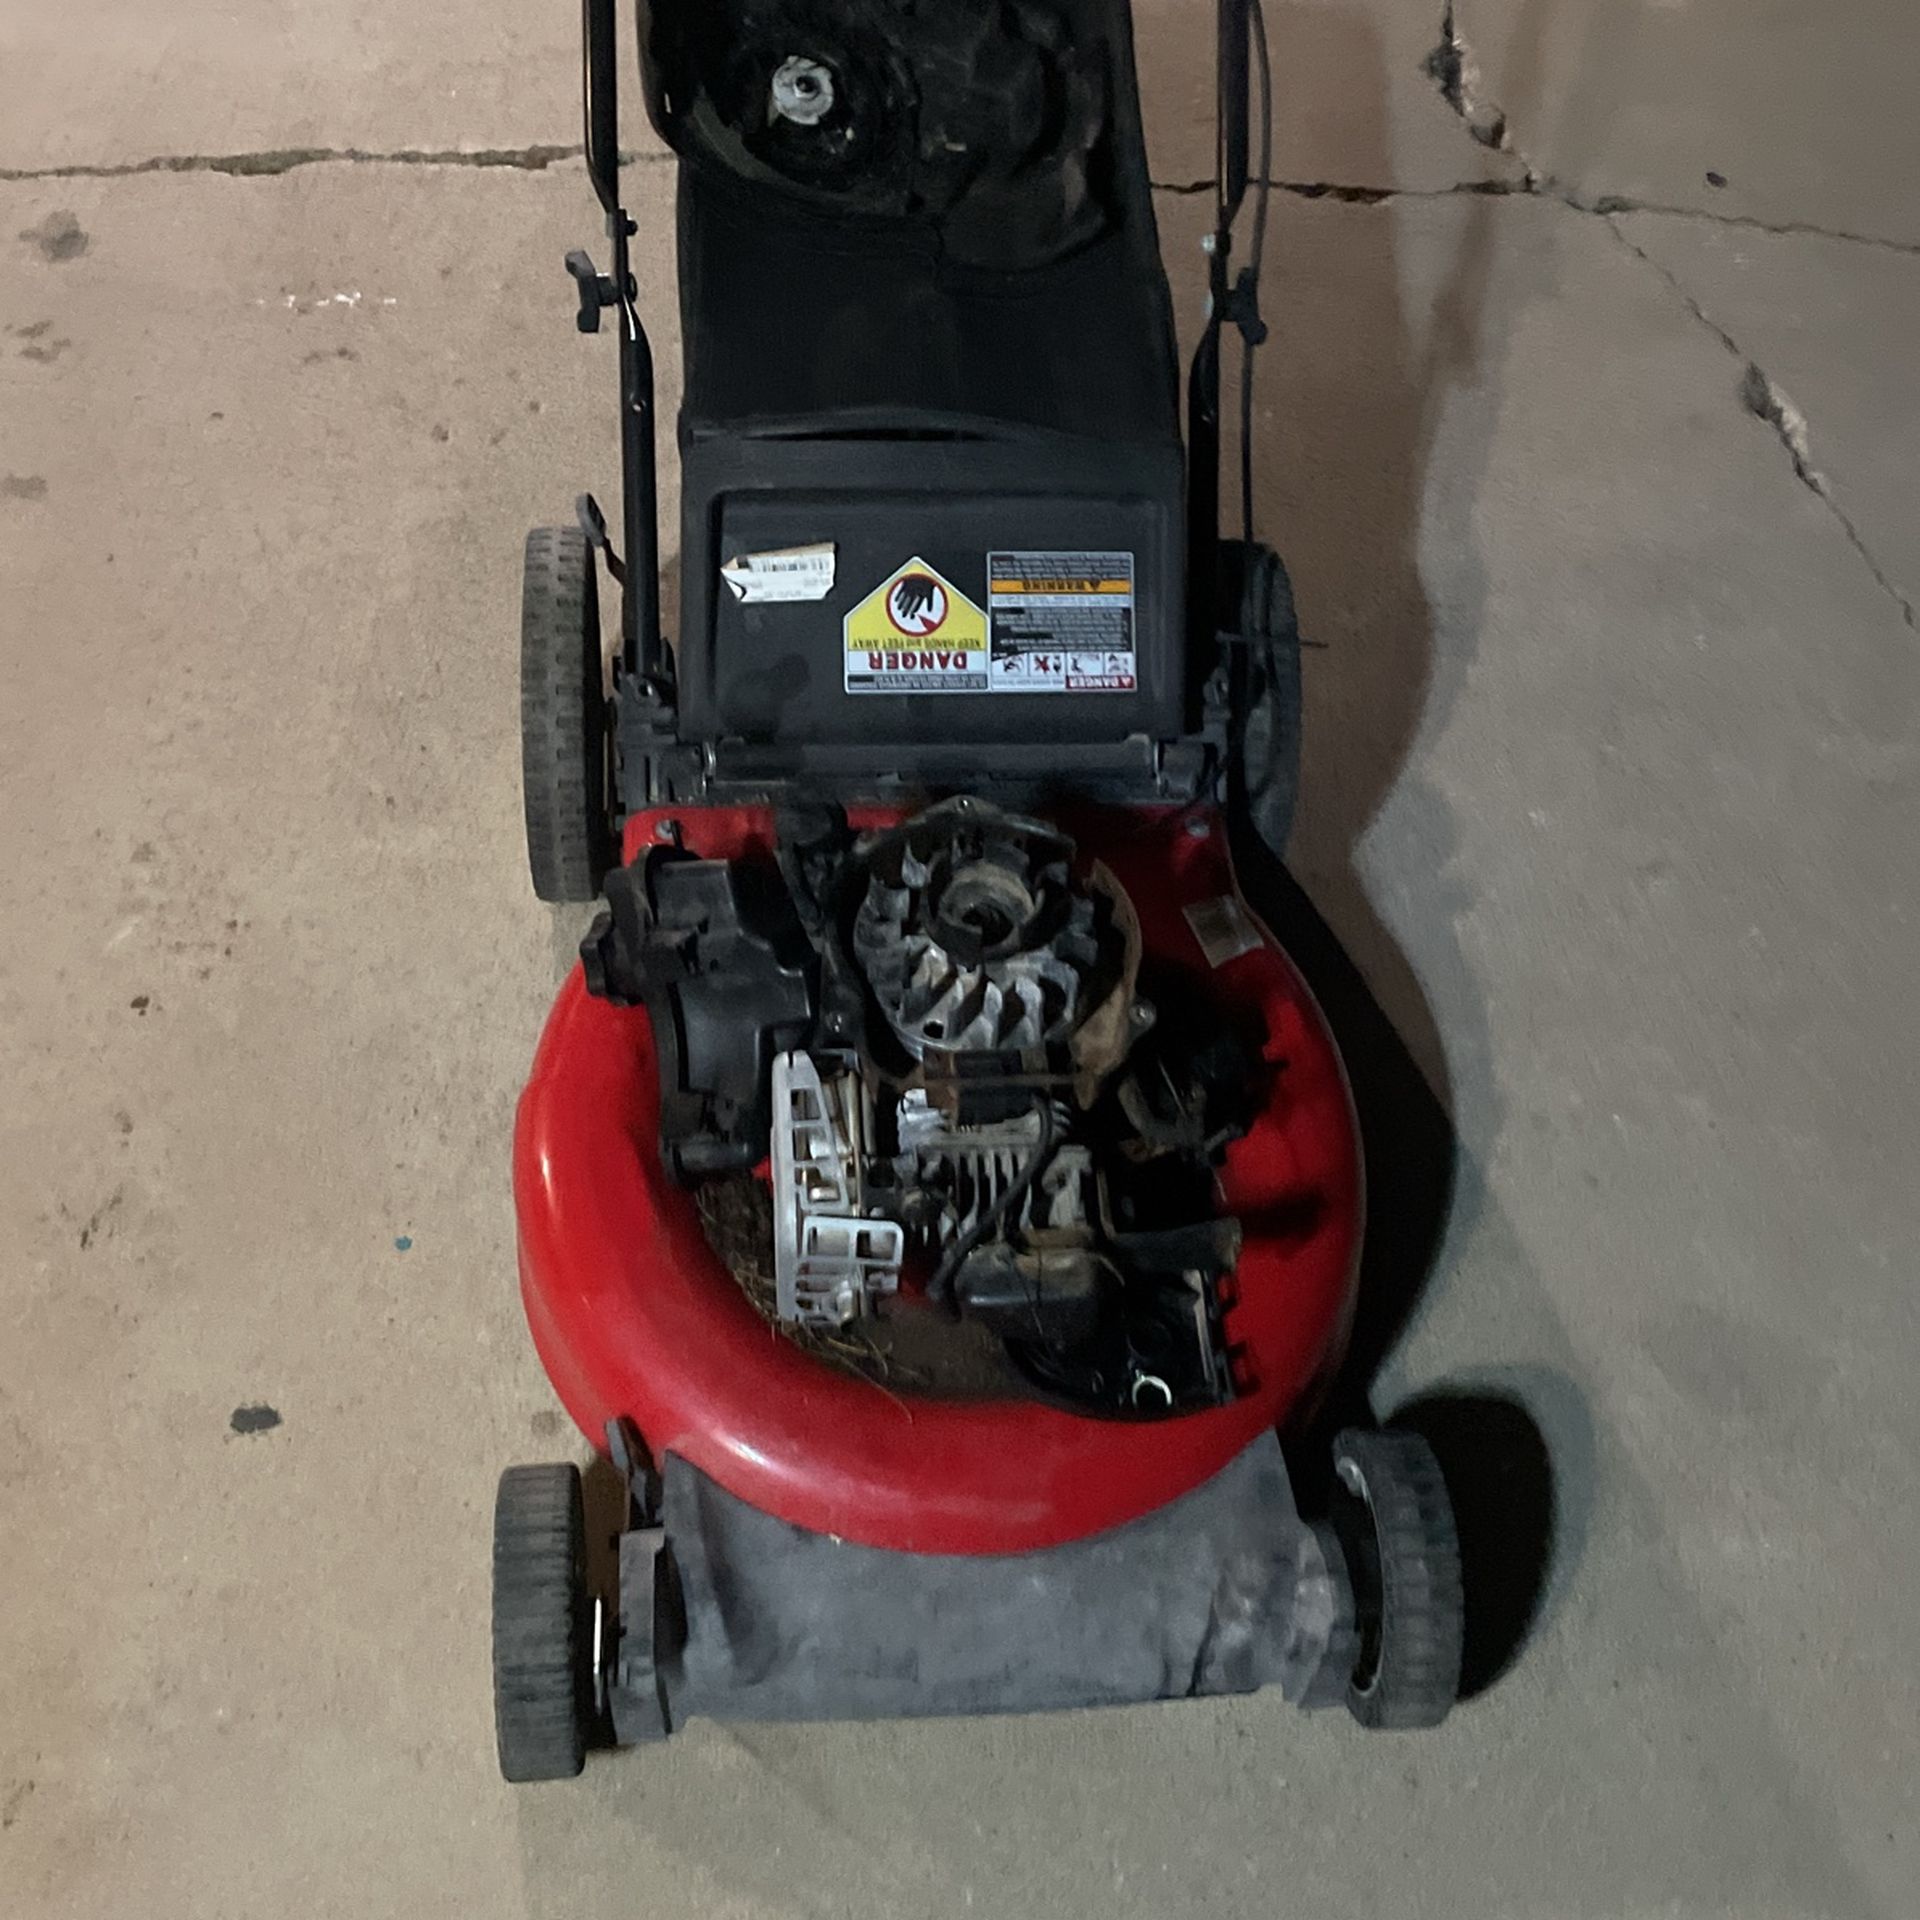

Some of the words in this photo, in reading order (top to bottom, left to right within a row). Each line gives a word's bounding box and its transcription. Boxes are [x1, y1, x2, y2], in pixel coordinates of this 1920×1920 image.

[1022, 580, 1084, 591] WARNING
[853, 639, 879, 648] AWAY
[882, 638, 904, 648] FEET
[906, 638, 922, 648] and
[923, 638, 955, 648] HANDS
[958, 638, 981, 648] KEEP
[868, 652, 967, 670] DANGER
[1068, 676, 1119, 688] DANGER
